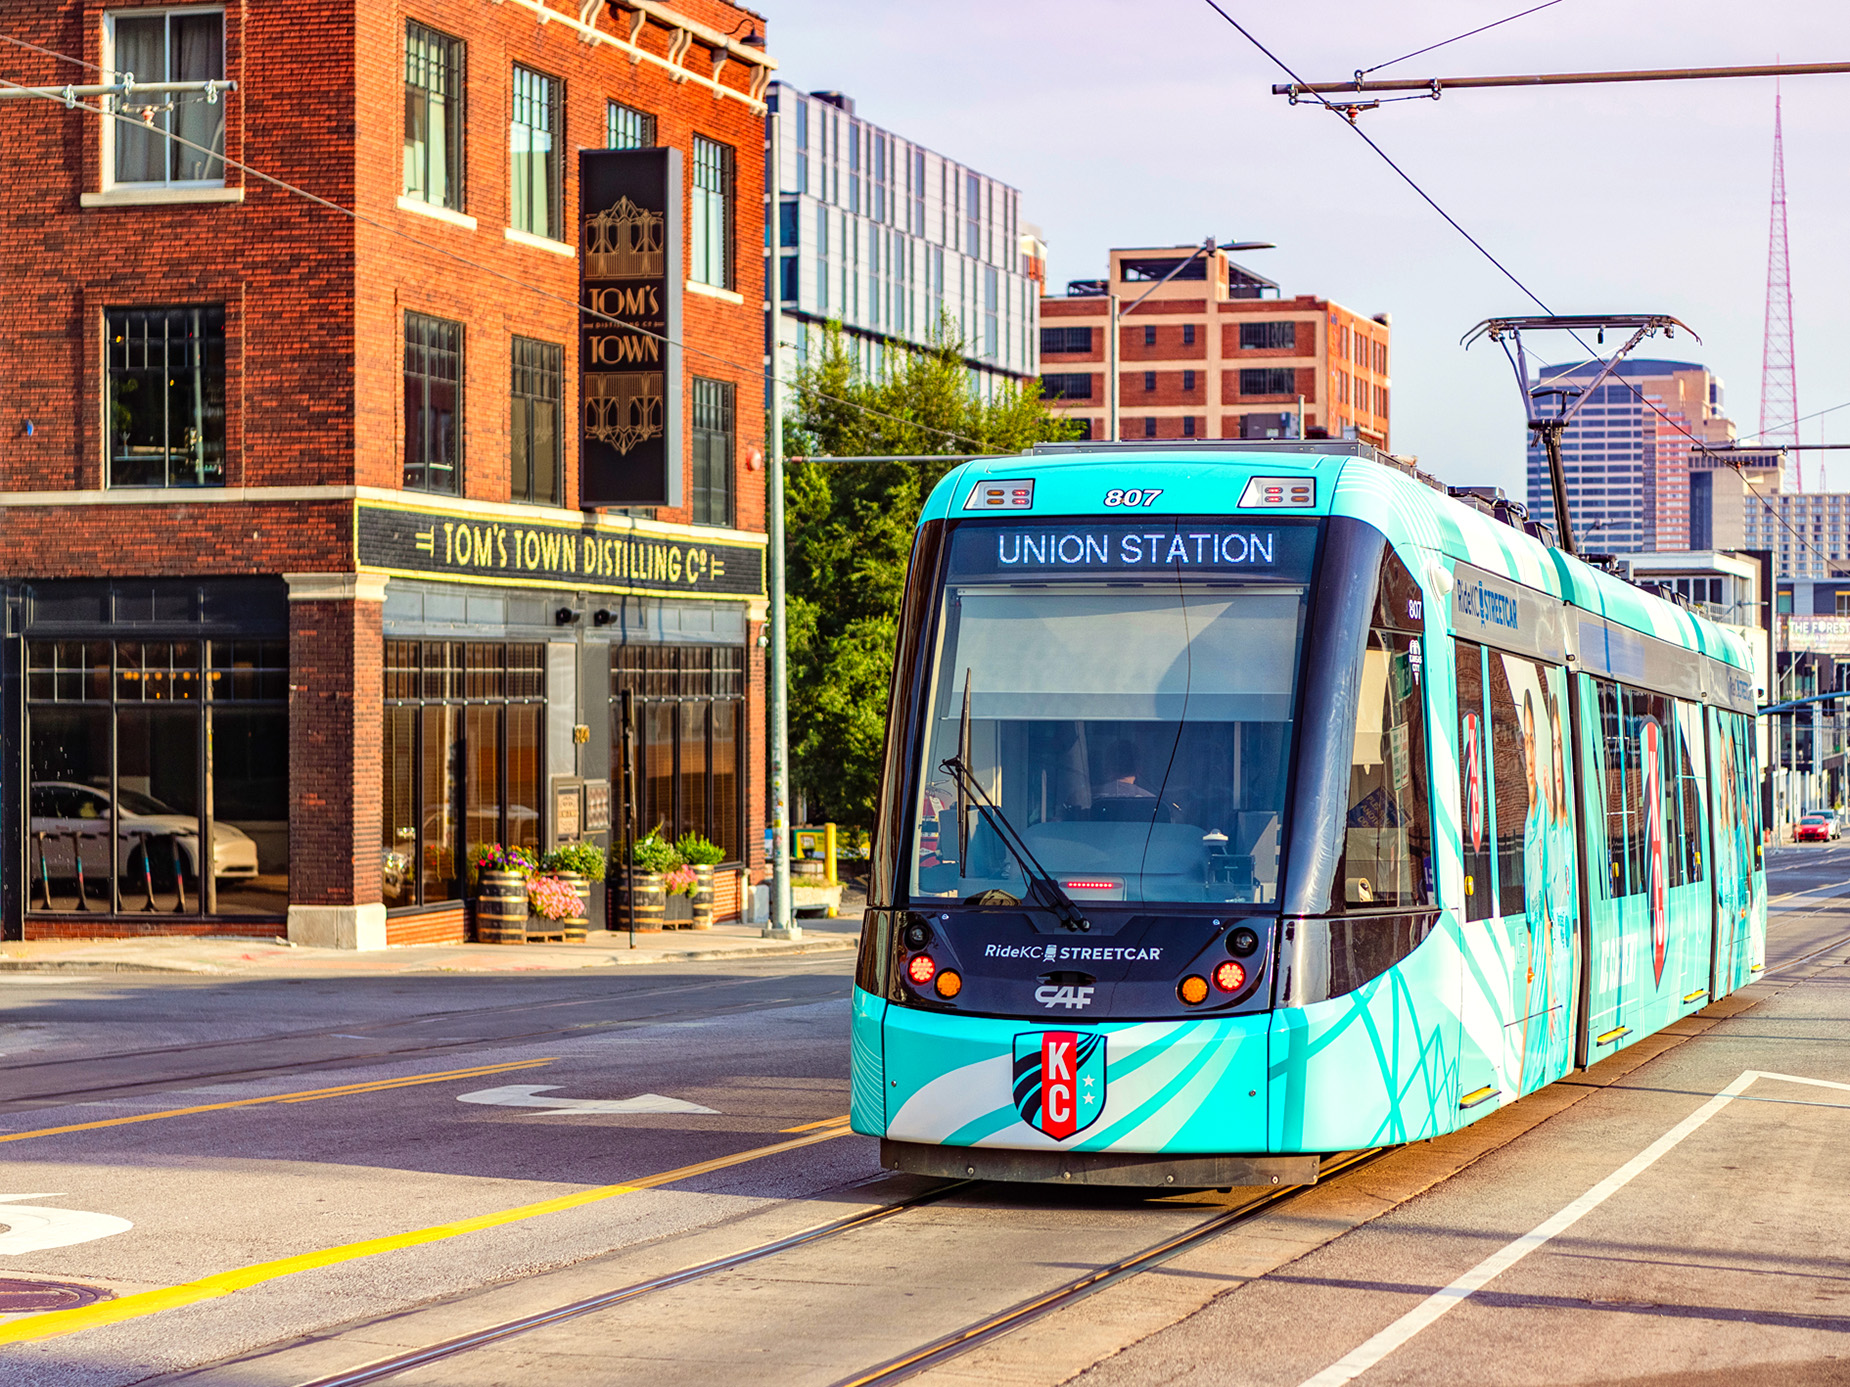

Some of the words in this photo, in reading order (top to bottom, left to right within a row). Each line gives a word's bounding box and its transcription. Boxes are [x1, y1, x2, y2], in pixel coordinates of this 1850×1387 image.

[588, 284, 660, 317] TOM'S
[588, 334, 660, 365] TOWN
[1102, 488, 1164, 507] 807
[443, 522, 508, 568] TOM'S
[514, 529, 576, 573] TOWN
[584, 536, 682, 582] DISTILLING
[998, 534, 1108, 564] UNION
[1120, 533, 1274, 564] STATION
[1408, 599, 1422, 620] 807
[1457, 578, 1480, 617] RideKC
[1484, 588, 1519, 630] STREETCAR
[1790, 621, 1809, 633] THE
[984, 944, 1043, 958] RideKC
[1034, 985, 1095, 1010] CAF
